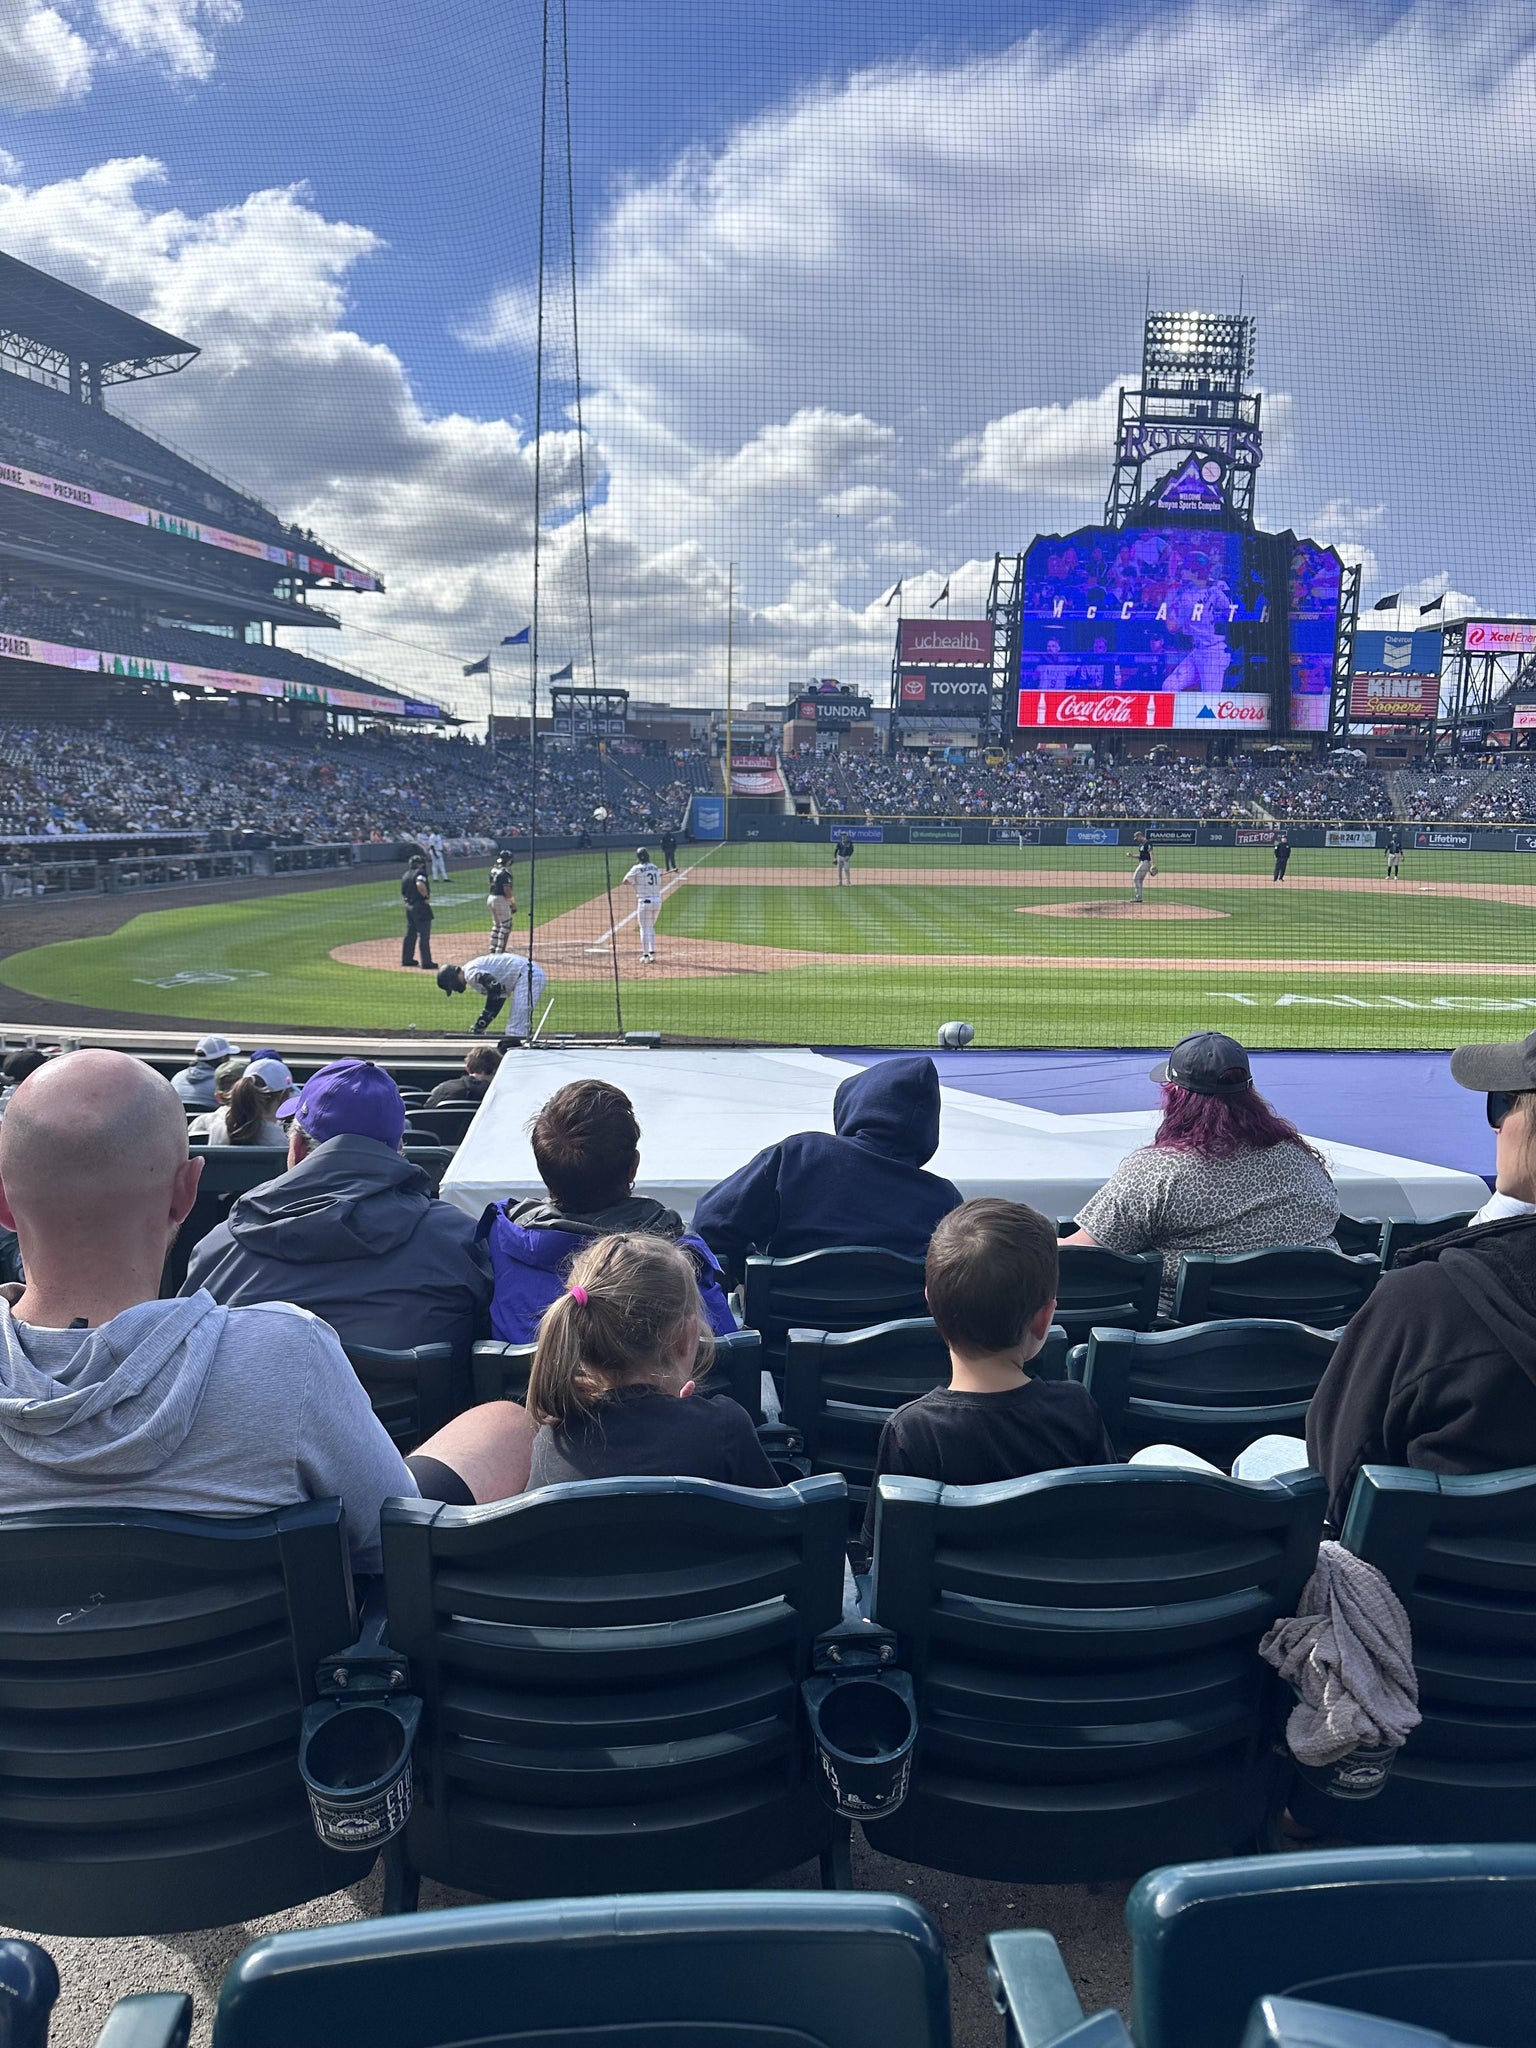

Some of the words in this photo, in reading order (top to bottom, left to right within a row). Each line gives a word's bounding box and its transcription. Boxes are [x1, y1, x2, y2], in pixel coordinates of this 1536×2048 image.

[1122, 424, 1264, 467] ROCKIES
[1179, 493, 1201, 501] WELCOME
[1158, 500, 1178, 511] Runyon
[1179, 500, 1197, 511] Sports
[1198, 501, 1221, 512] Complex
[914, 631, 980, 649] uchealth
[1384, 635, 1413, 643] Chevron
[930, 682, 989, 695] TOYOTA
[1367, 679, 1424, 698] KING
[1217, 701, 1265, 720] Coors
[1365, 696, 1424, 713] Soopers
[816, 705, 867, 718] TUNDRA
[1462, 729, 1481, 737] PLATTE
[732, 756, 772, 767] uchealth
[857, 830, 881, 838] mobile
[1429, 834, 1467, 844] Lifetime
[647, 872, 658, 886] 31
[328, 1820, 381, 1836] ROCKIES
